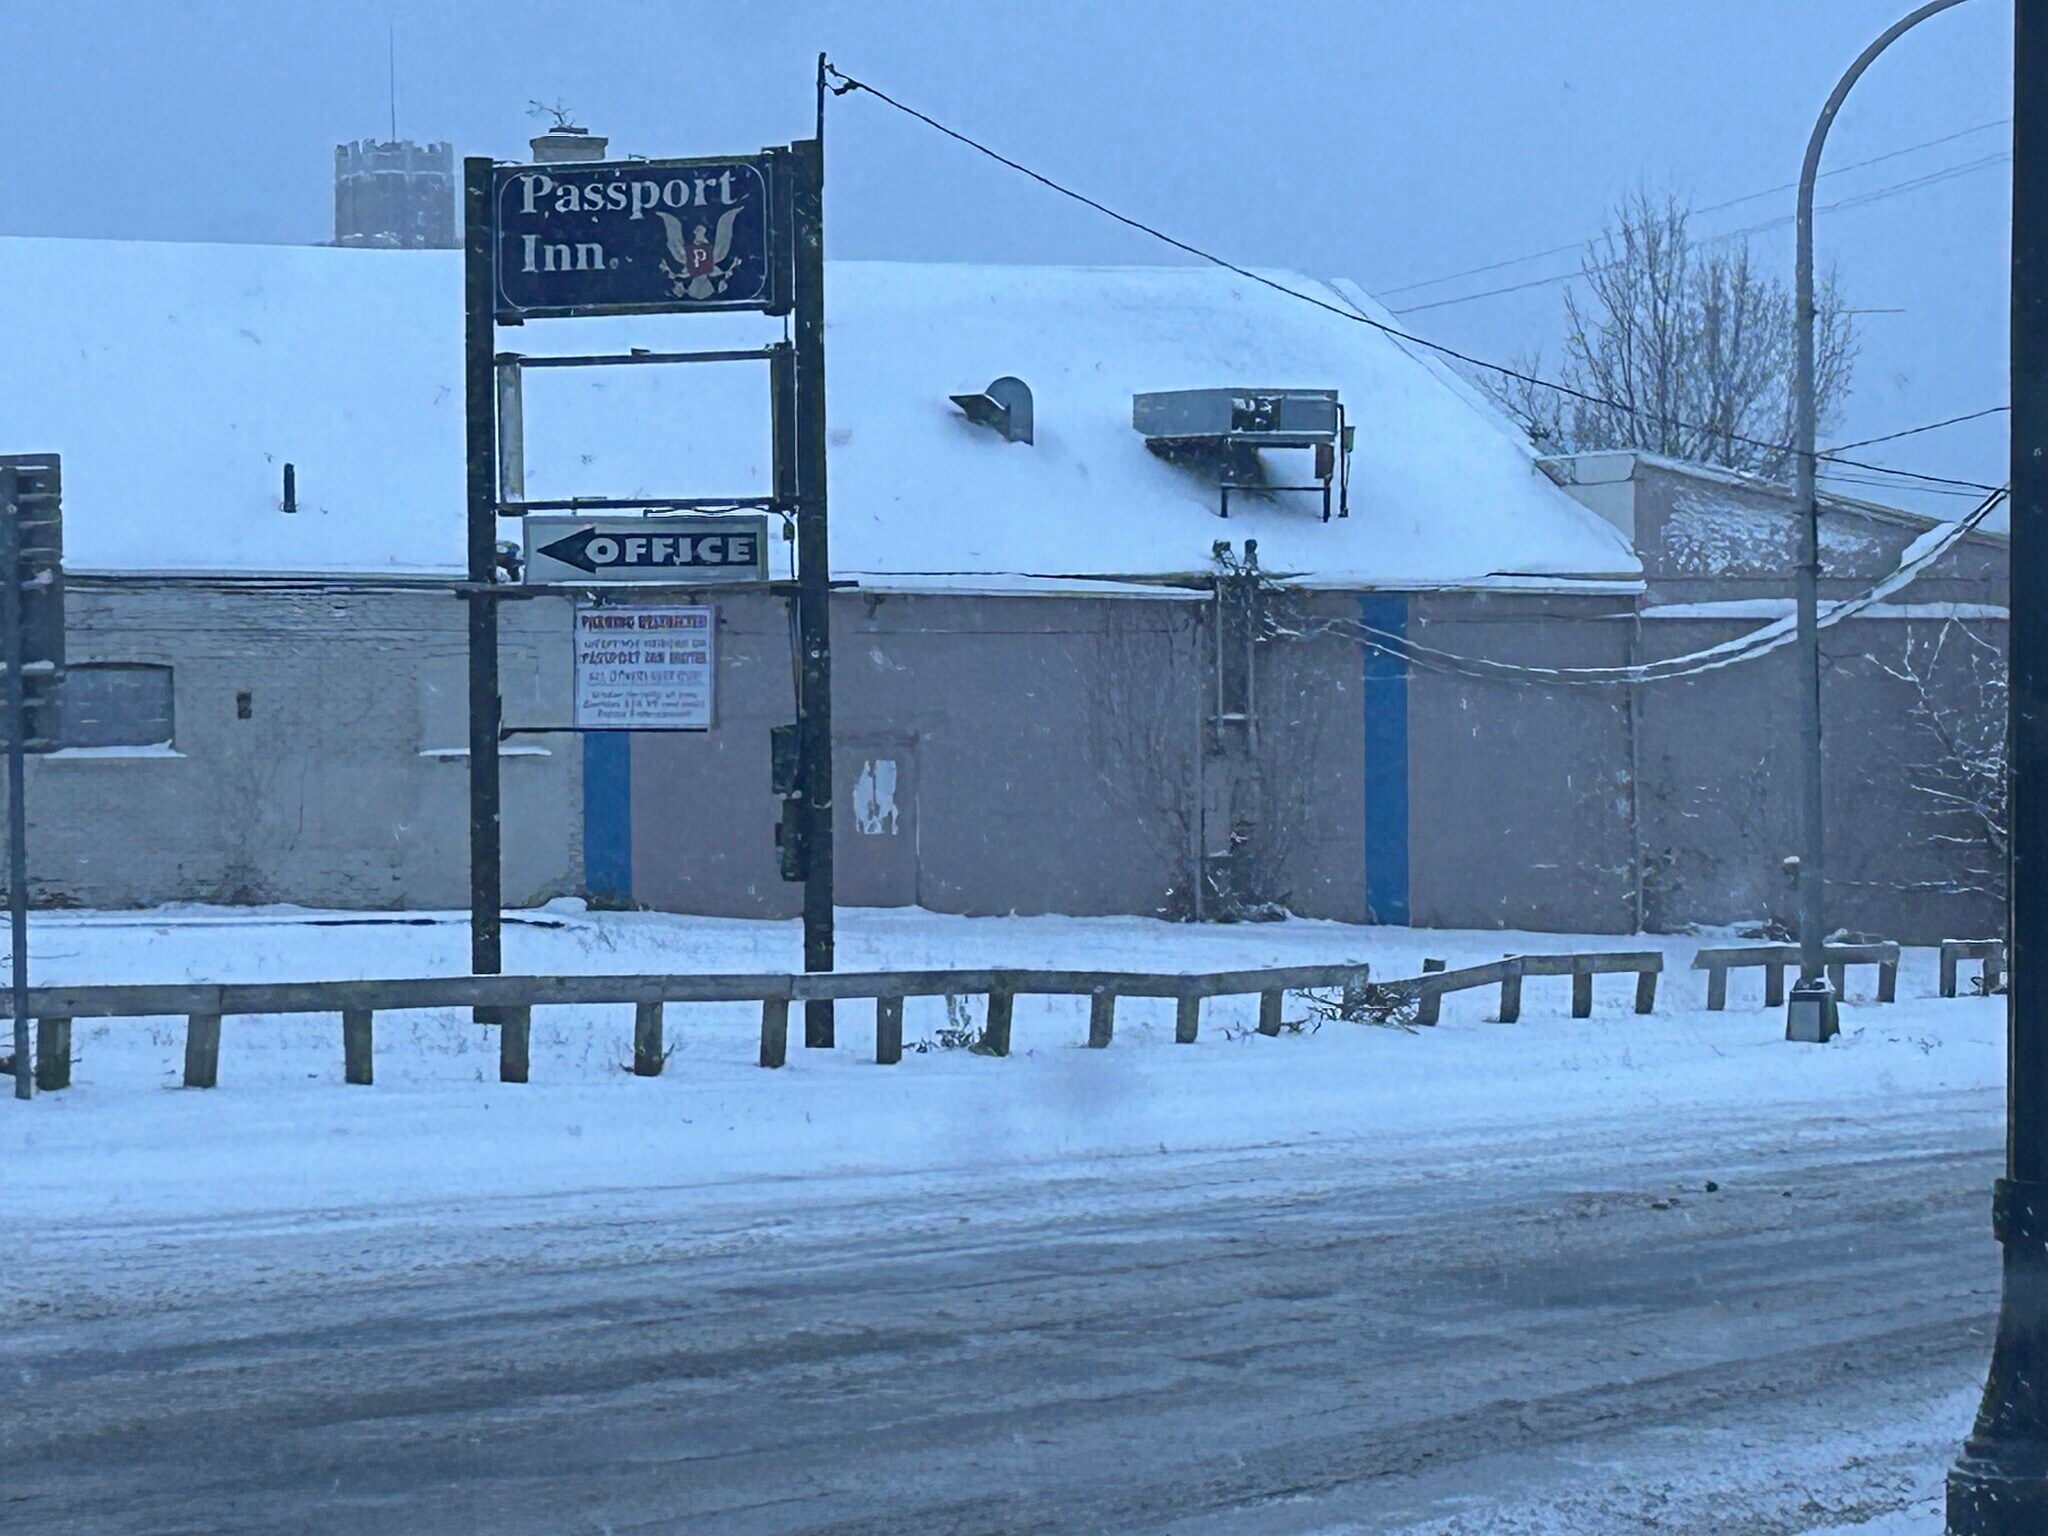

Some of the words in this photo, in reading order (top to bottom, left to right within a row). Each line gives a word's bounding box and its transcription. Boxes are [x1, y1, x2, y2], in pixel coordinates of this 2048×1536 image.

[520, 170, 737, 220] Passport
[521, 234, 605, 273] Inn
[585, 537, 750, 564] OFFICE
